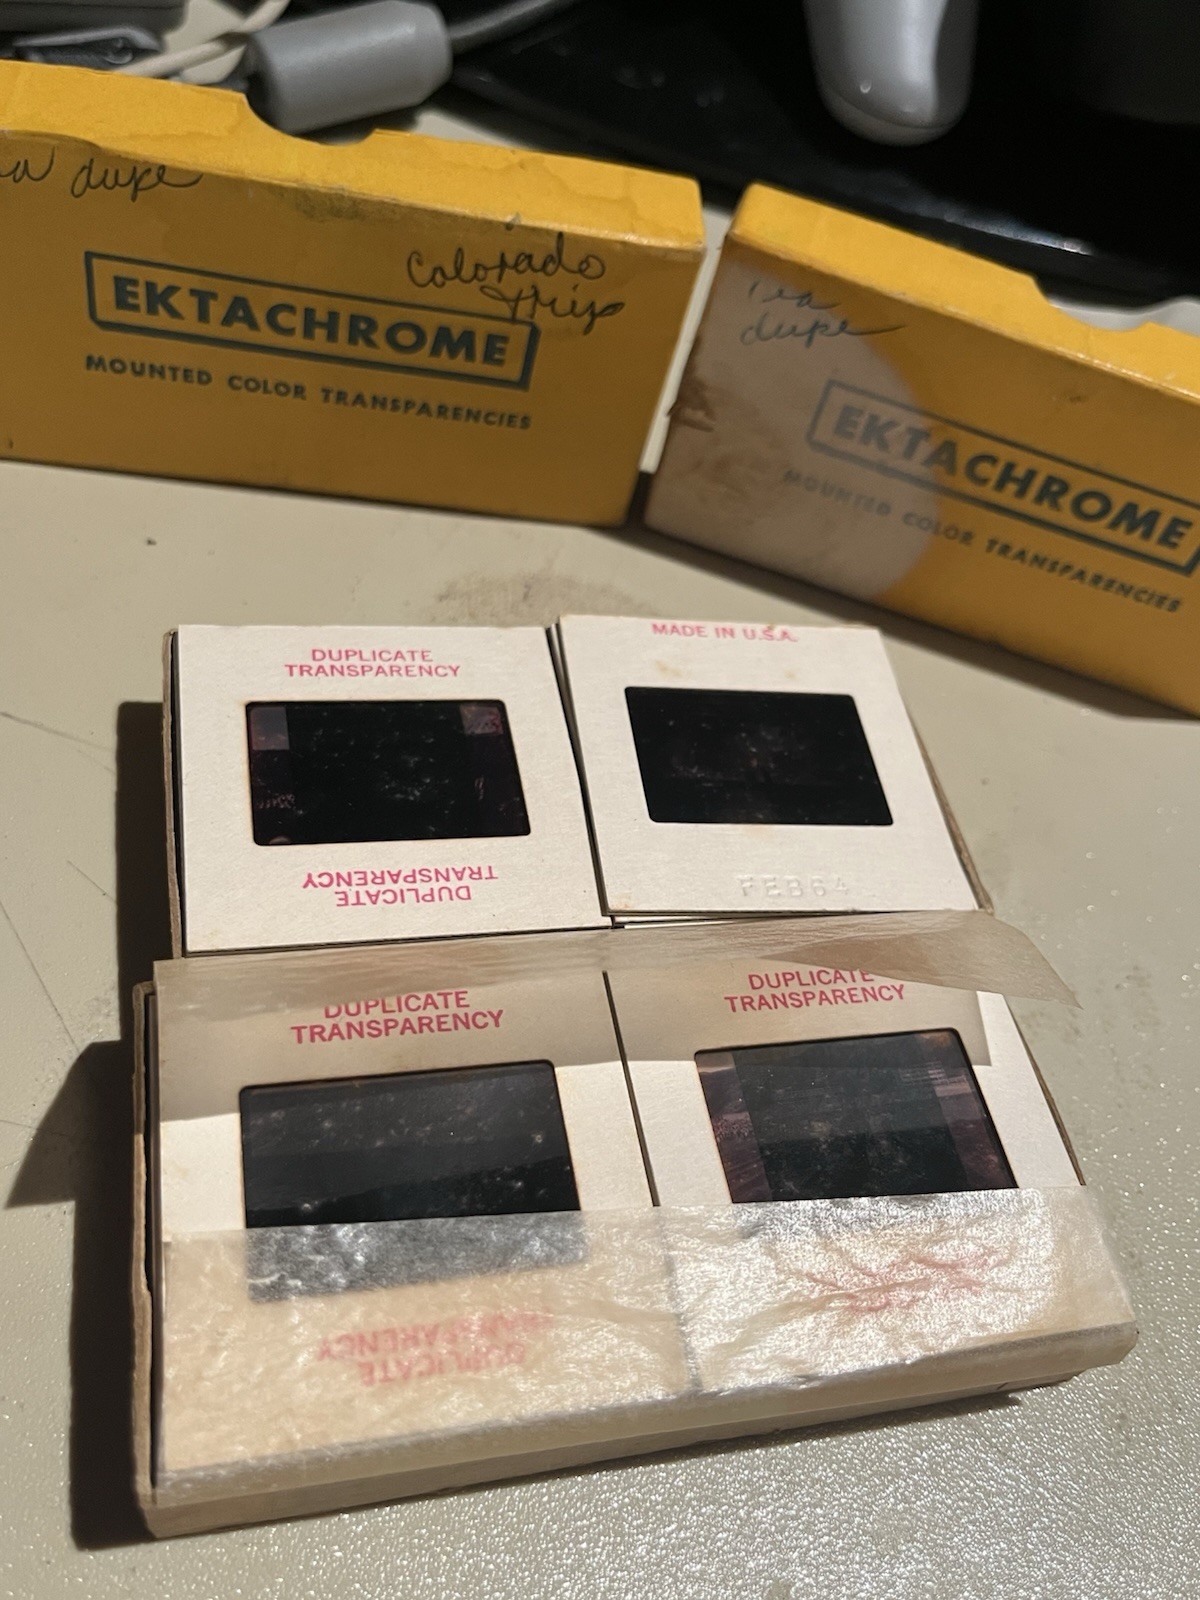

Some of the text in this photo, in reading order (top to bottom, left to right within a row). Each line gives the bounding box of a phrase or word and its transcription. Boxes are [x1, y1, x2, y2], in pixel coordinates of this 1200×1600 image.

[71, 158, 203, 202] dupe
[407, 231, 606, 289] Colorado
[113, 275, 511, 367] EKTACHROME
[86, 354, 532, 430] MOUNTED COLOR TRANSPARENCIES
[833, 405, 1192, 550] EKTACHROME
[783, 470, 1183, 614] MOUNTED COLOR TRANSPARENCIES
[652, 623, 798, 642] MADE IN U.S.A.
[311, 648, 433, 662] DUPLICATE
[284, 664, 461, 678] TRANSPARENCY
[302, 865, 499, 889] TRANSPARENCY
[335, 885, 472, 907] DUPLICATE
[748, 968, 875, 990] DUPLICATE
[324, 990, 470, 1019] DUPLICATE
[724, 984, 904, 1013] TRANSPARENCY
[291, 1009, 504, 1044] TRANSPARENCY
